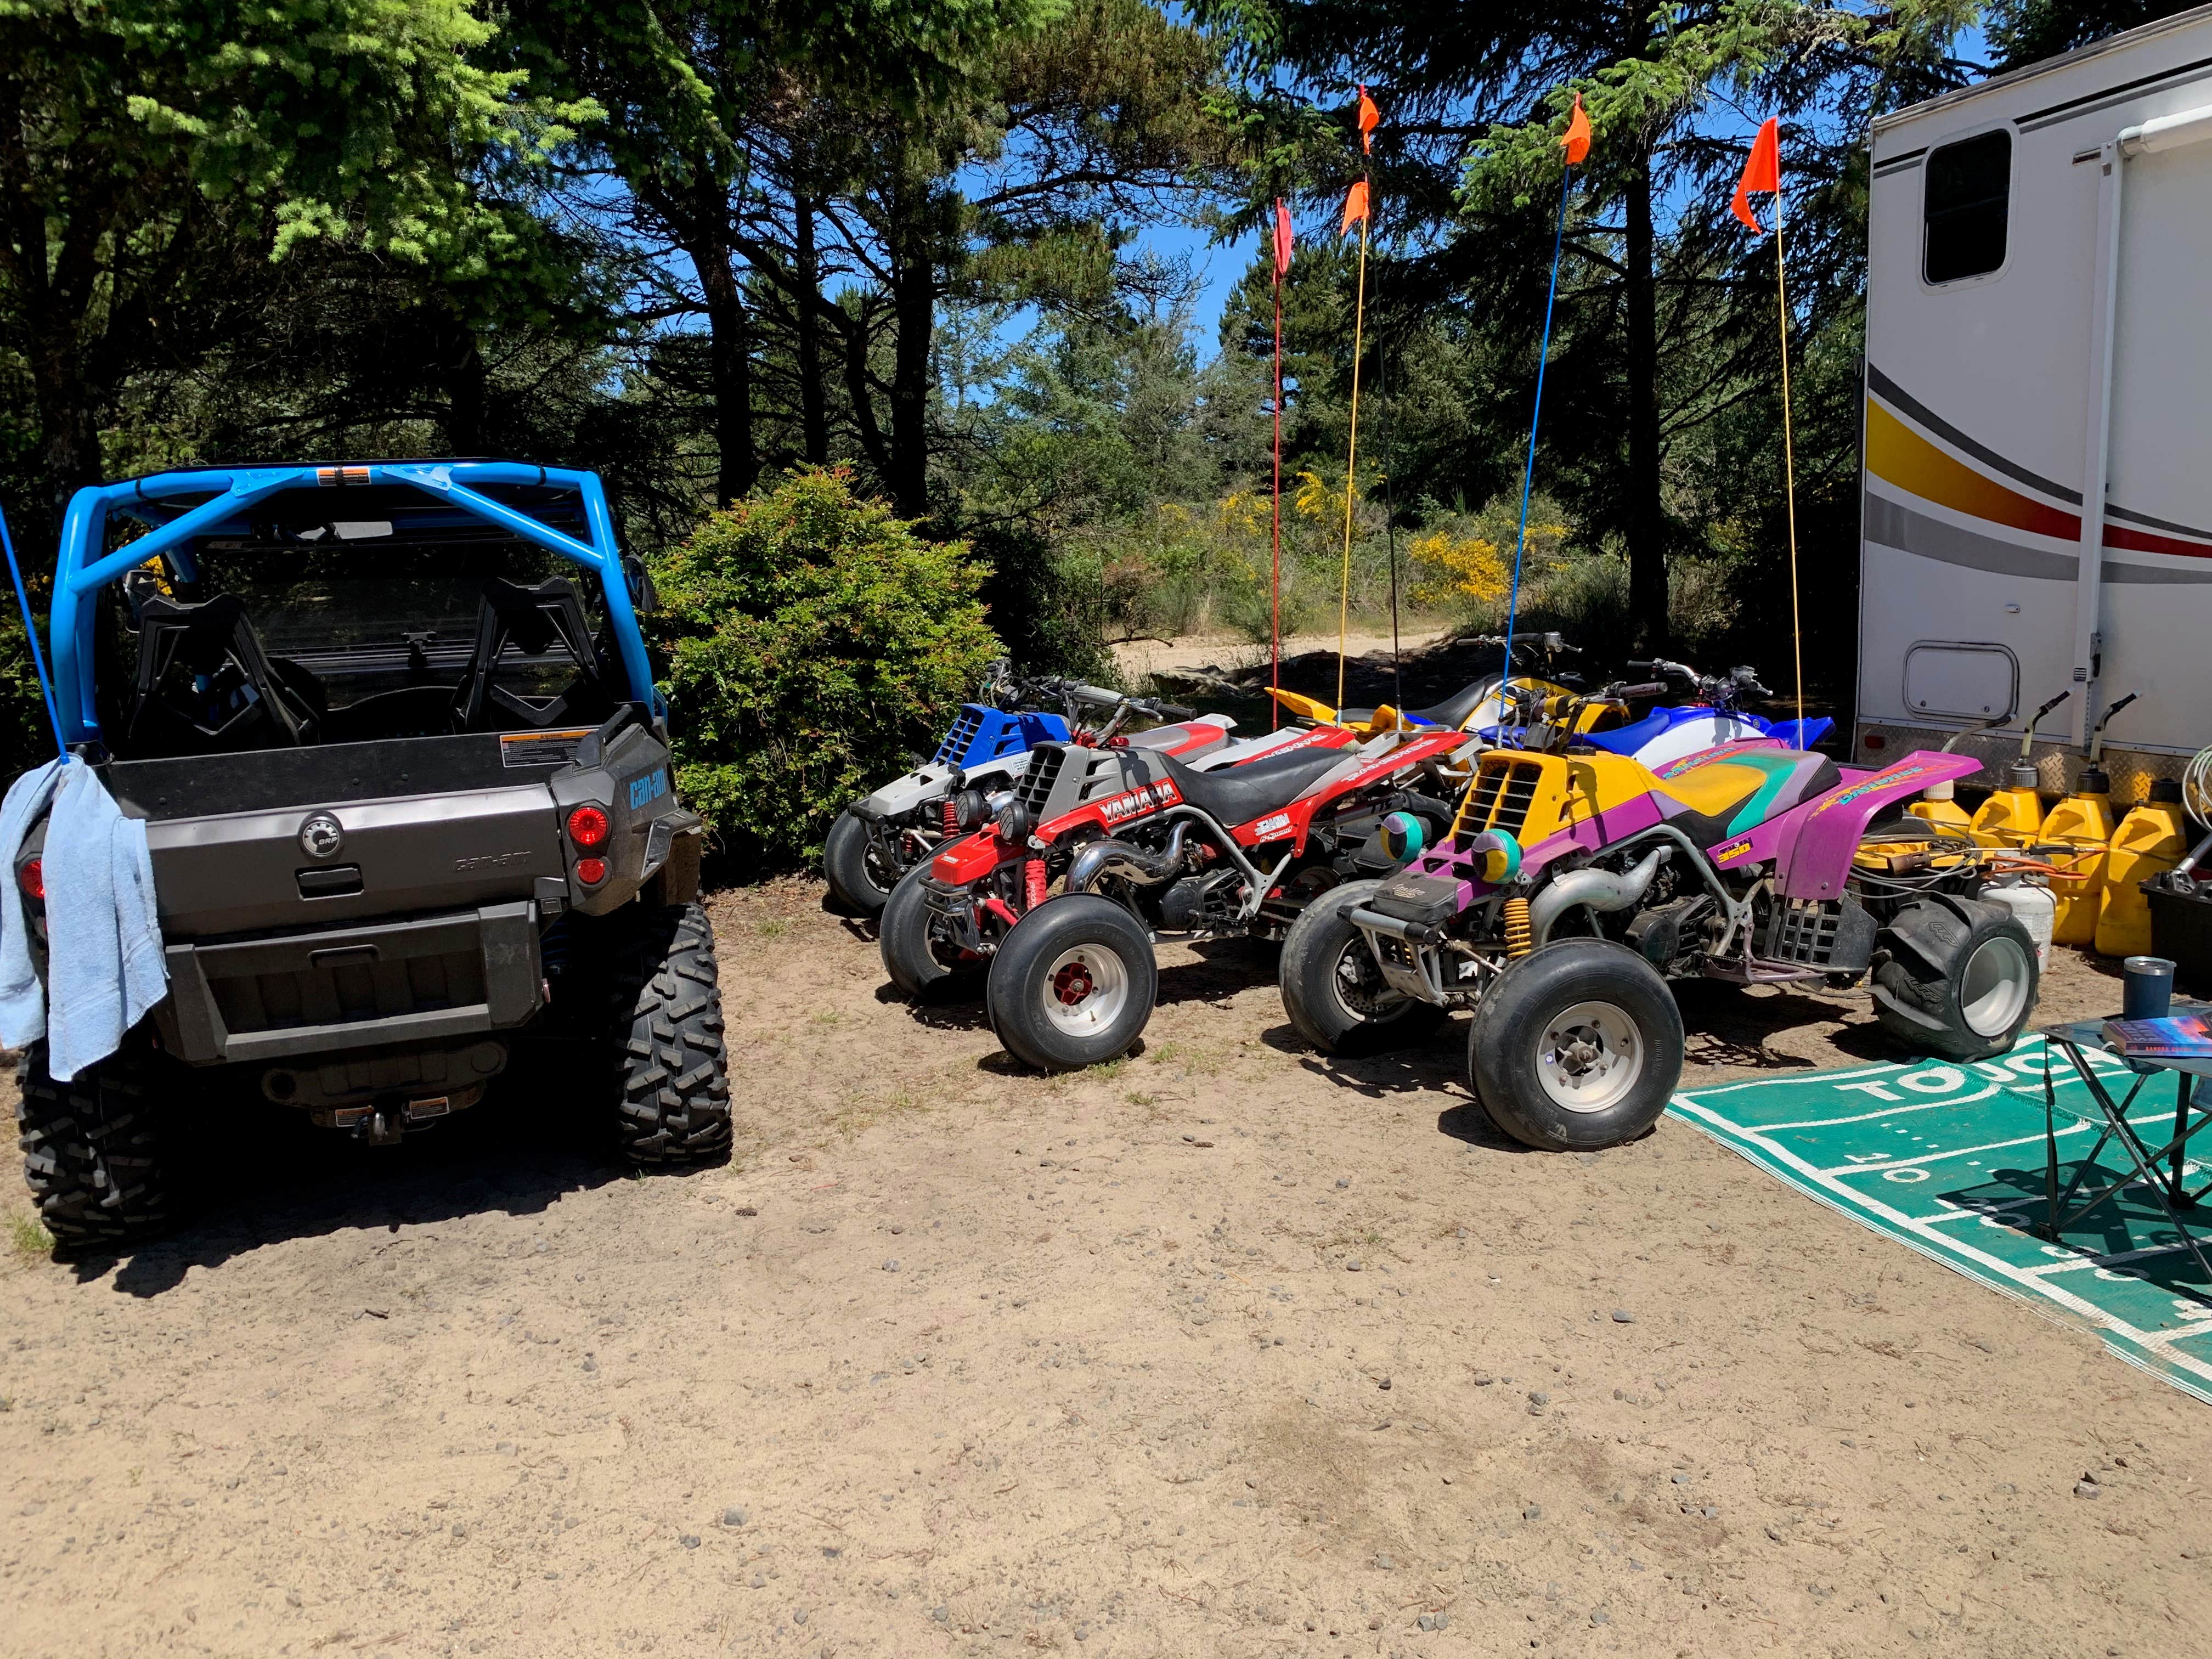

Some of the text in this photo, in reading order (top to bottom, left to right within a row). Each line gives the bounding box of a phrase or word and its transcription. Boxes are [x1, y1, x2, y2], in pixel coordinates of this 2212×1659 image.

[630, 768, 666, 810] can-am
[1838, 766, 1925, 806] BANSHEE
[1099, 781, 1177, 823] YAMAHA
[318, 837, 337, 845] BRP
[1717, 843, 1751, 864] 350
[453, 851, 531, 872] can-am
